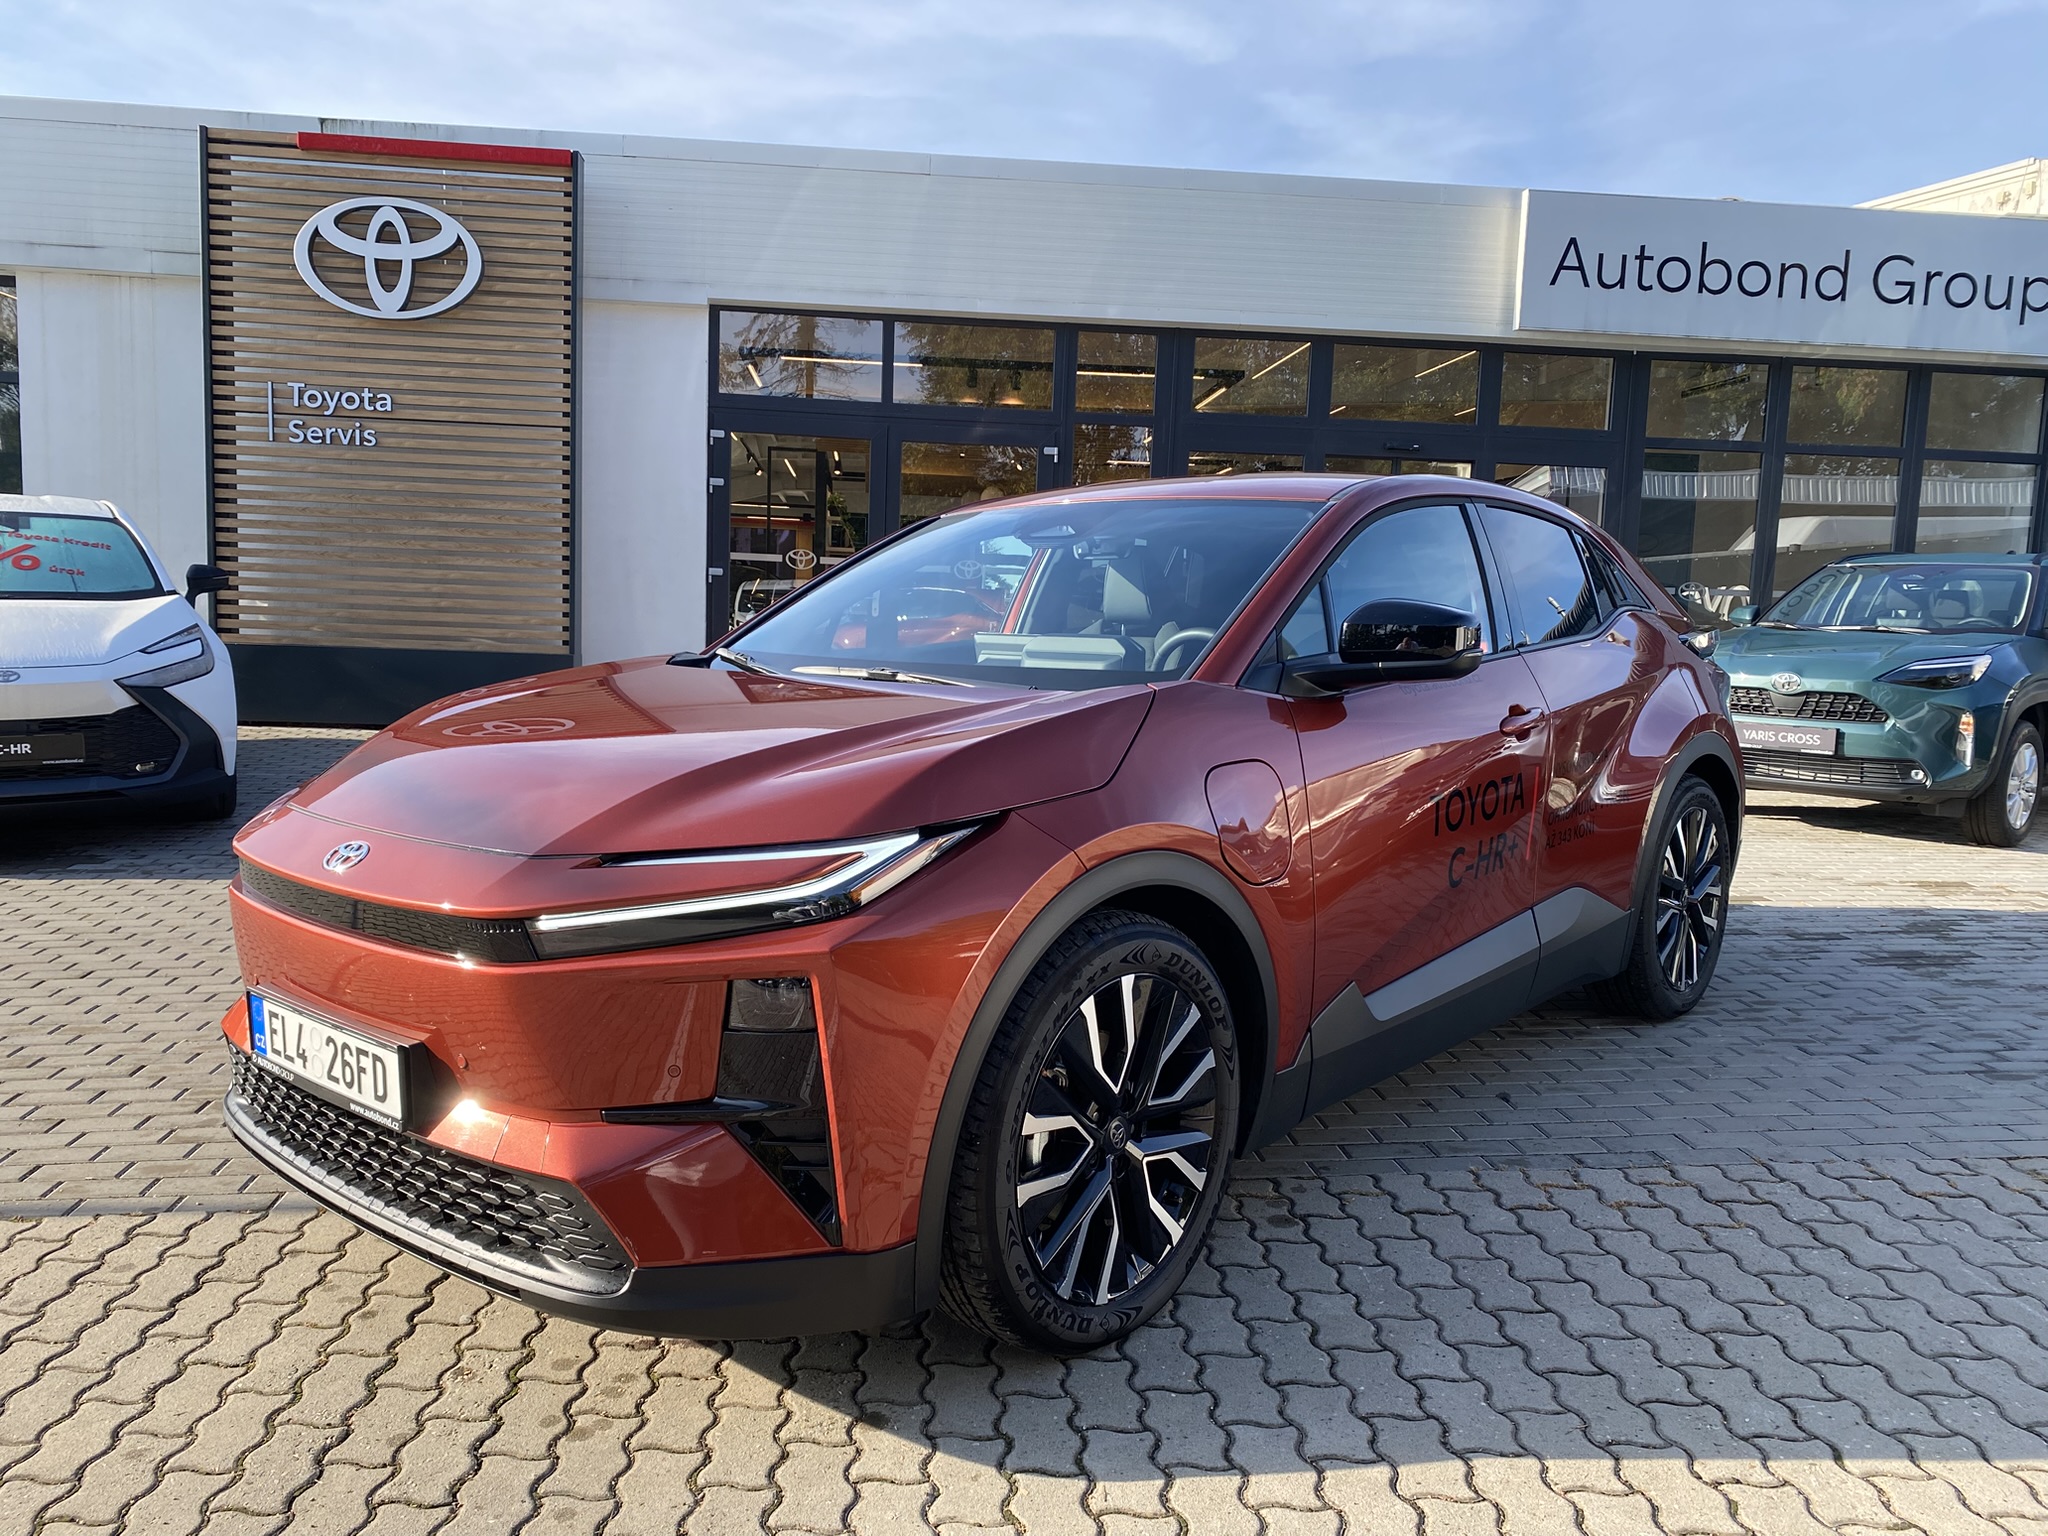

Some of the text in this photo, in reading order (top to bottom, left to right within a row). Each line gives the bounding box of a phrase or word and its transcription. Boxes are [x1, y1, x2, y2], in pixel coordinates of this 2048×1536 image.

[1549, 236, 2048, 326] Autobond Group
[287, 382, 393, 416] Toyota
[288, 419, 377, 447] Servis
[8, 531, 111, 550] Toyota Kredit
[49, 565, 85, 576] úrok
[1743, 729, 1821, 745] YARIS CROSS
[1430, 773, 1525, 836] TOYOTA
[1558, 827, 1572, 846] 343
[1448, 832, 1519, 889] C-HR+
[1163, 952, 1230, 1031] DUNLOP
[255, 1032, 266, 1049] CZ
[268, 1010, 389, 1103] EL4 26FD
[350, 1102, 400, 1131] www.autobond.cz
[1015, 1264, 1094, 1334] DUNLOP
